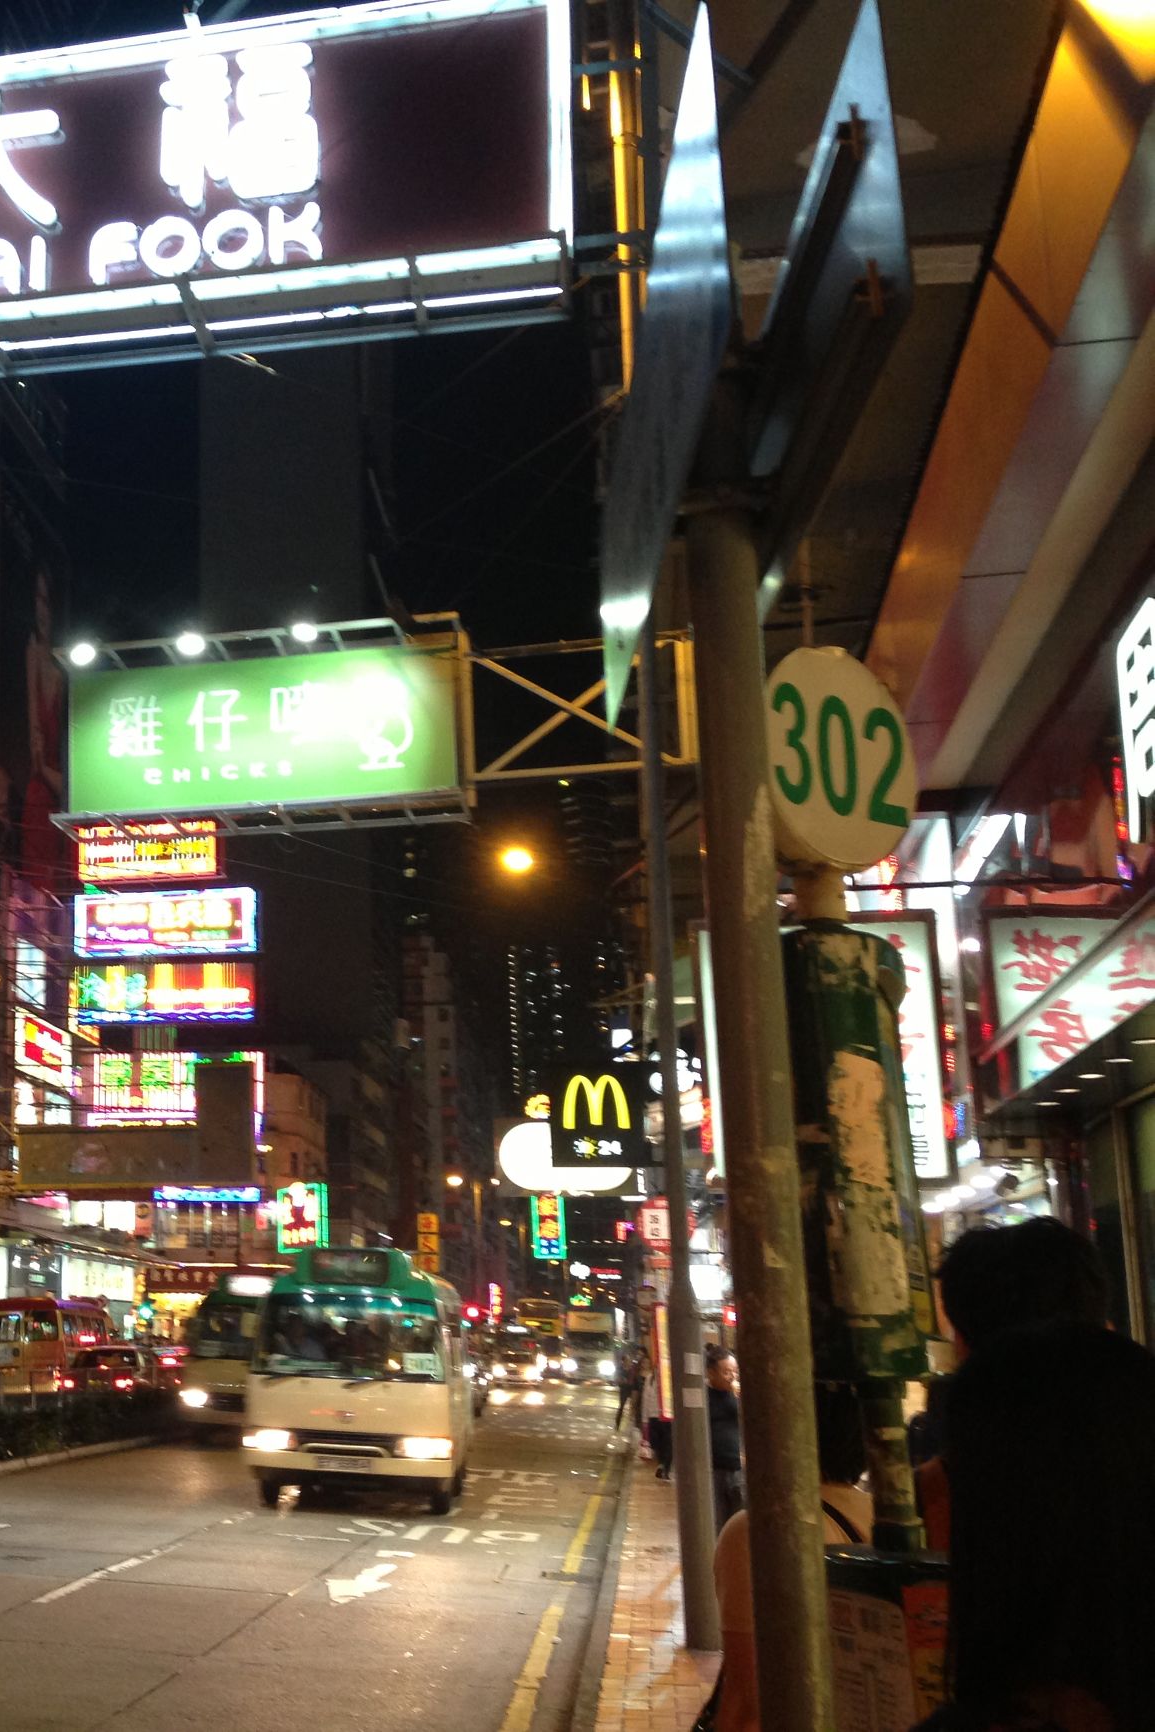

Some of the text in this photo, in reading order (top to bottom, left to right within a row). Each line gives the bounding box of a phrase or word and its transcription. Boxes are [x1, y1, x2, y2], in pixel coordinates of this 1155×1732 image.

[88, 200, 322, 286] FOOK
[143, 759, 294, 785] CHICKS
[772, 682, 909, 828] 302
